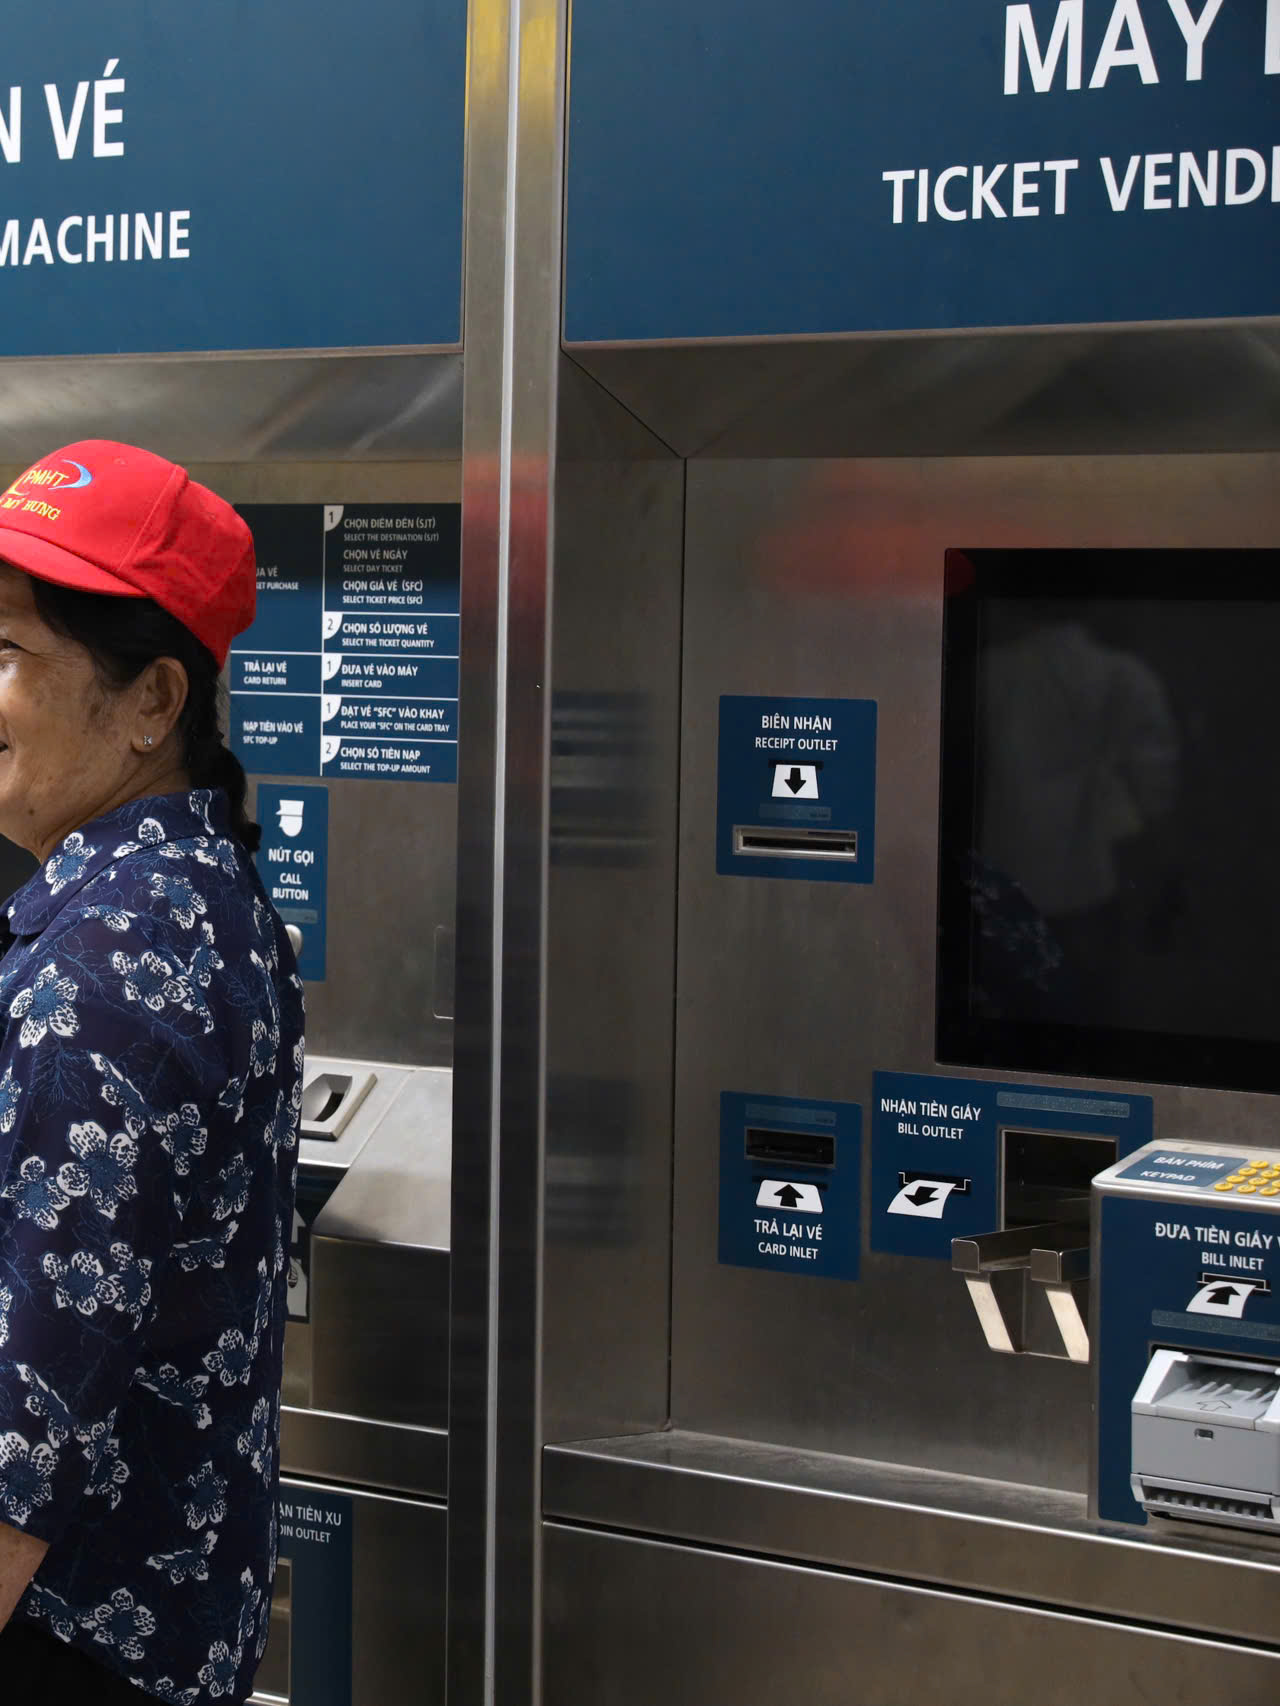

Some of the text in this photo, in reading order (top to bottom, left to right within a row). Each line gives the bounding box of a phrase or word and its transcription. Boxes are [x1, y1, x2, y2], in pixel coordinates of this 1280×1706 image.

[43, 58, 125, 161] VÉ
[882, 159, 1079, 224] TICKET
[329, 512, 334, 523] 1
[344, 533, 365, 541] SELECT
[368, 533, 378, 541] THE
[381, 533, 423, 541] DESTINATION
[267, 582, 299, 590] PURCHASE
[402, 580, 423, 592] (SFC)
[343, 596, 365, 604] SELECT
[366, 596, 387, 604] TICKET
[388, 596, 405, 604] PRICE
[328, 619, 333, 630] 2
[342, 622, 368, 635] CHỌN
[342, 638, 434, 648] SELECT THE TICKET QUANTITY
[244, 676, 286, 685] CARD RETURN
[341, 679, 382, 688] INSERT CARD
[419, 708, 444, 719] KHAY
[341, 721, 358, 729] PLACE
[394, 722, 403, 730] ON
[404, 723, 415, 731] THE
[417, 723, 433, 731] CARD
[434, 724, 449, 732] TRAY
[762, 712, 832, 733] BIÊN NHẬN
[755, 737, 838, 751] RECEIPT OUTLET
[341, 747, 365, 760] CHỌN
[340, 762, 431, 773] SELECT THE TOP-UP AMOUNT
[268, 846, 314, 867] NÚT GỌI
[280, 873, 302, 885] CALL
[272, 887, 309, 900] BUTTON
[881, 1098, 916, 1117] NHẬN
[898, 1122, 963, 1139] BILL OUTLET
[1140, 1171, 1195, 1181] KEYPAD
[754, 1218, 822, 1240] TRẢ LẠI VÉ
[1155, 1222, 1191, 1240] ĐƯA
[758, 1242, 818, 1259] CARD INLET
[1202, 1251, 1264, 1271] BILL INLET
[325, 1511, 341, 1526] XU
[296, 1527, 331, 1543] OUTLET
